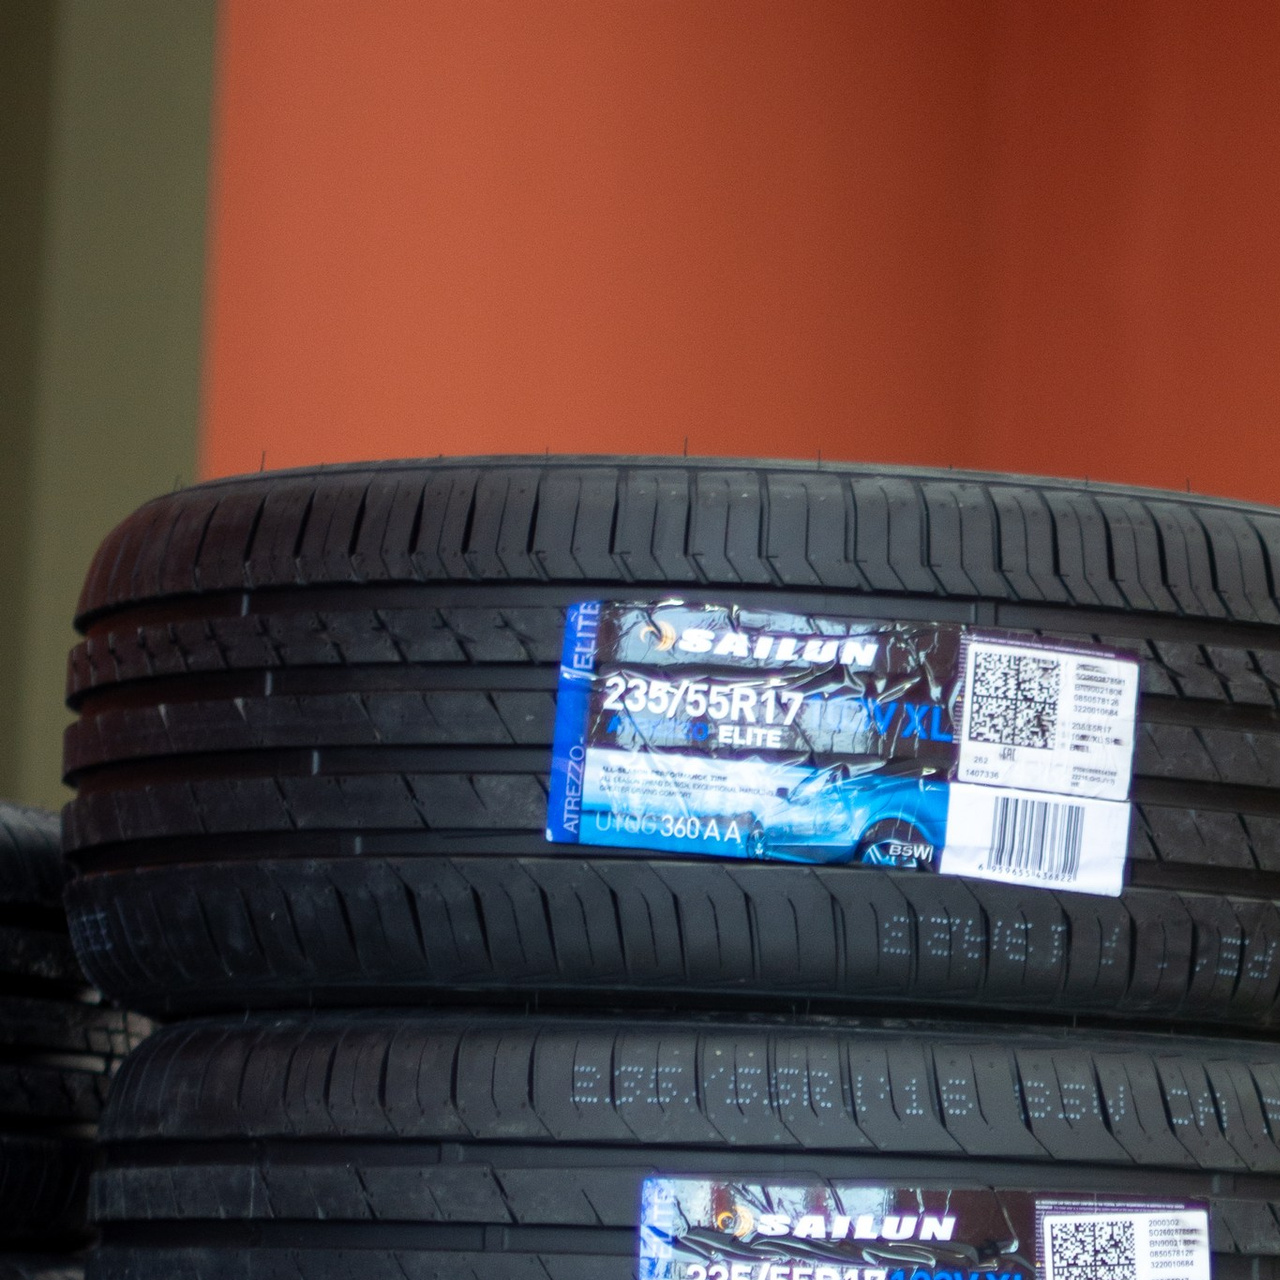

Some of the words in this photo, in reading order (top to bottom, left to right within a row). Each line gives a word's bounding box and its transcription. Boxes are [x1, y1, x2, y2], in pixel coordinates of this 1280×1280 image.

[573, 601, 600, 669] ELITE
[679, 628, 879, 666] SAILUN
[603, 676, 804, 726] 235/55R17
[901, 701, 954, 743] XL
[717, 724, 783, 749] ELITE
[563, 746, 584, 834] ATREZZO
[659, 814, 700, 840] 360
[888, 844, 931, 861] BSW
[757, 1213, 956, 1241] SAILUN
